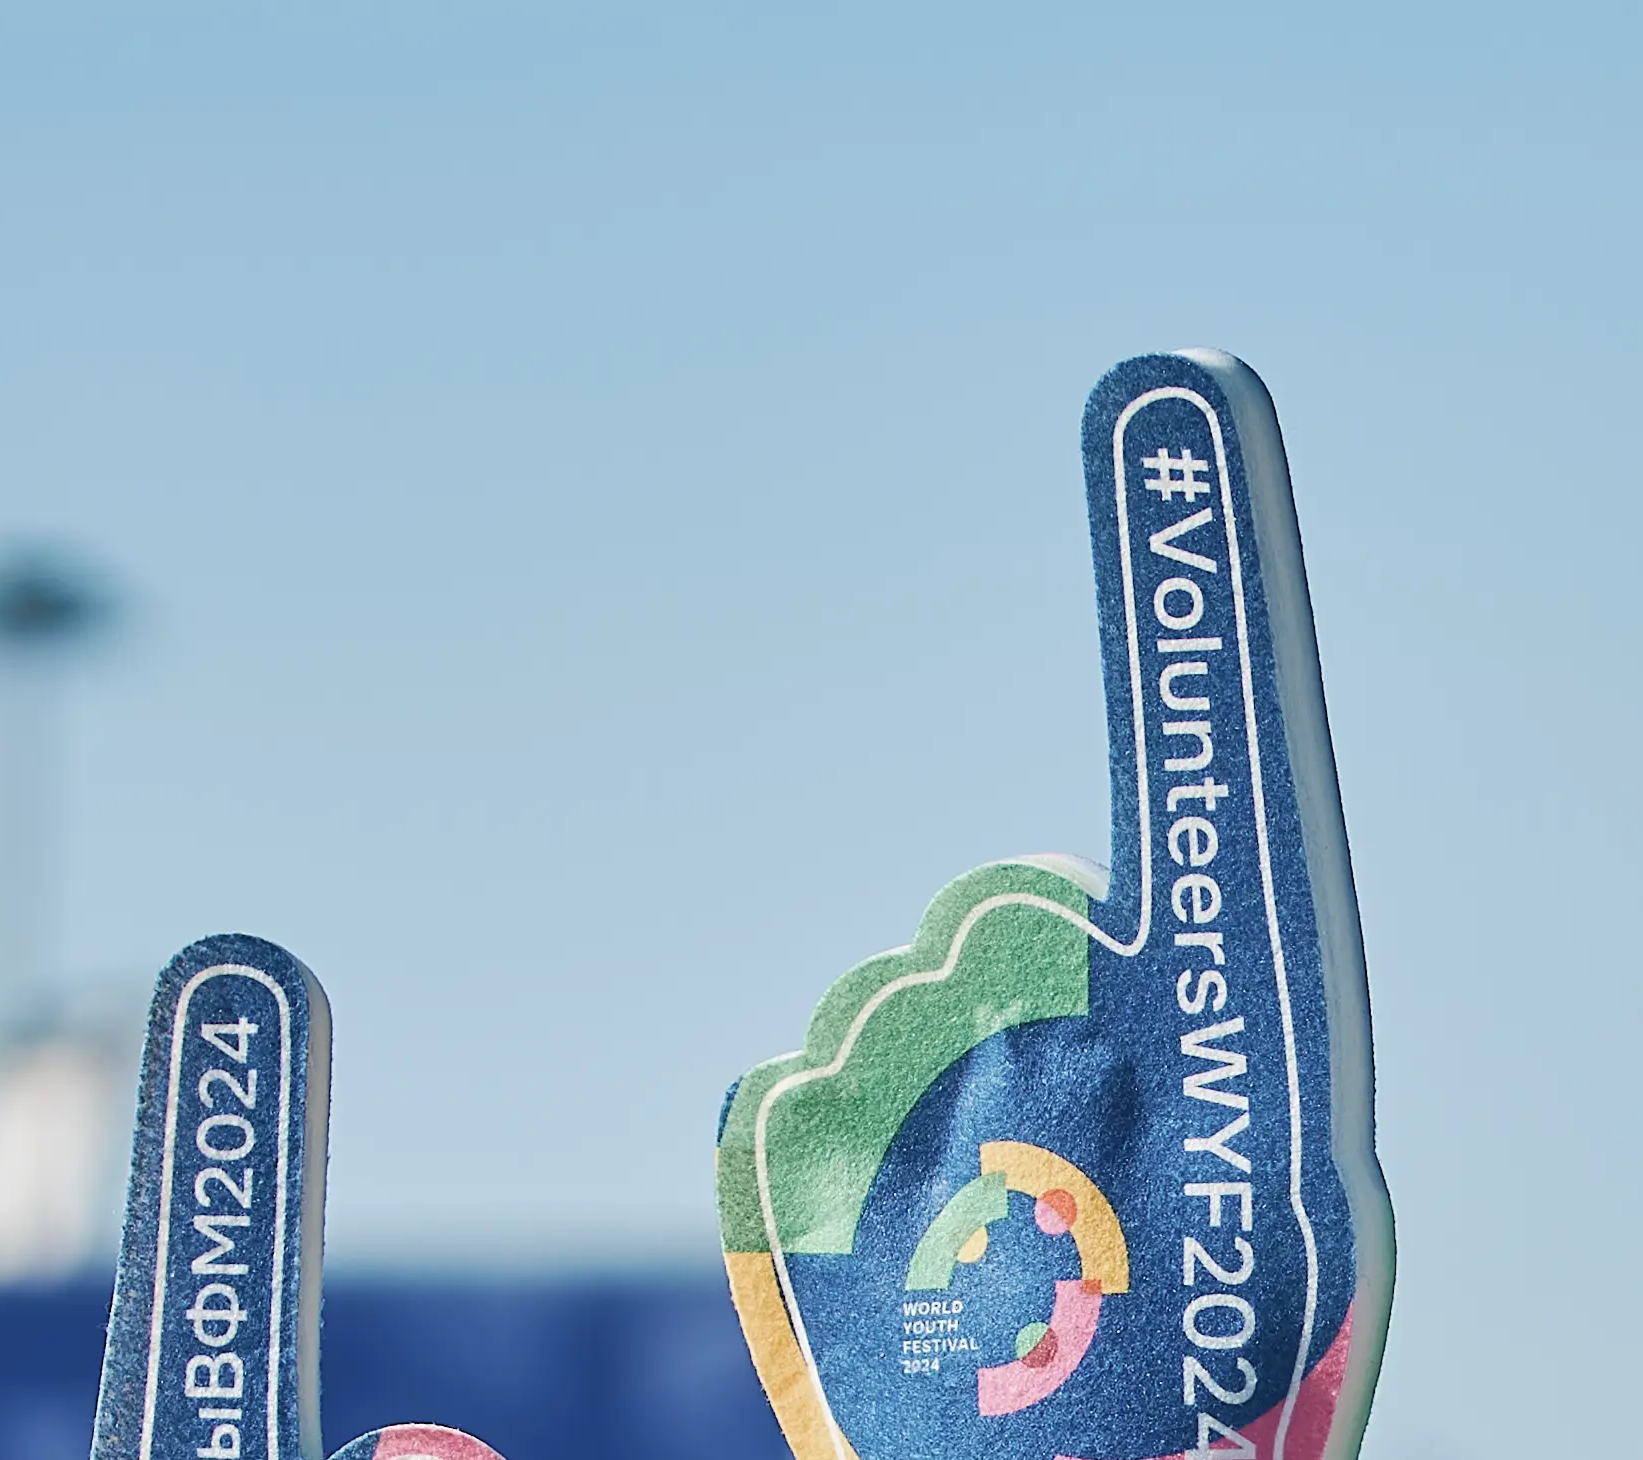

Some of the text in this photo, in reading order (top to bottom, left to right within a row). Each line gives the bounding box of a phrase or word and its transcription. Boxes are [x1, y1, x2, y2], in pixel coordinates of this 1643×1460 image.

[903, 1300, 963, 1316] WORLD
[903, 1319, 958, 1334] YOUTH
[902, 1337, 979, 1354] FESTIVAL
[901, 1357, 939, 1374] 2024
